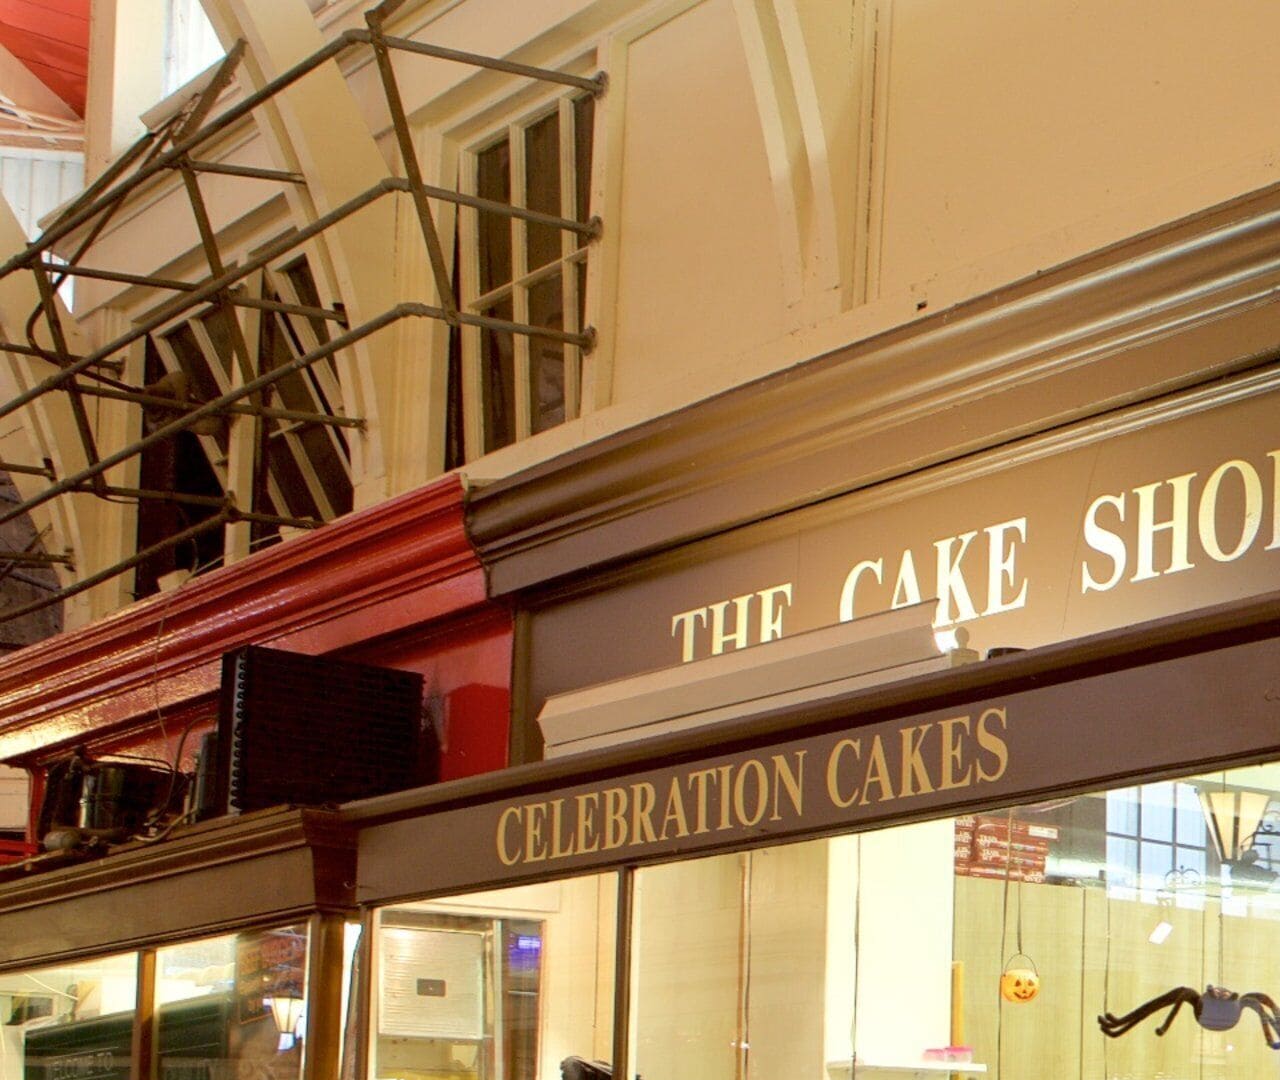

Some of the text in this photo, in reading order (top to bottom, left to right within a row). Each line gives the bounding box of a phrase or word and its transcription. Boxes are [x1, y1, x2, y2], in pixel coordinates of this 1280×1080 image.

[671, 582, 793, 664] THE
[839, 516, 1029, 629] CAKE
[497, 706, 1008, 866] CELEBRATION CAKES
